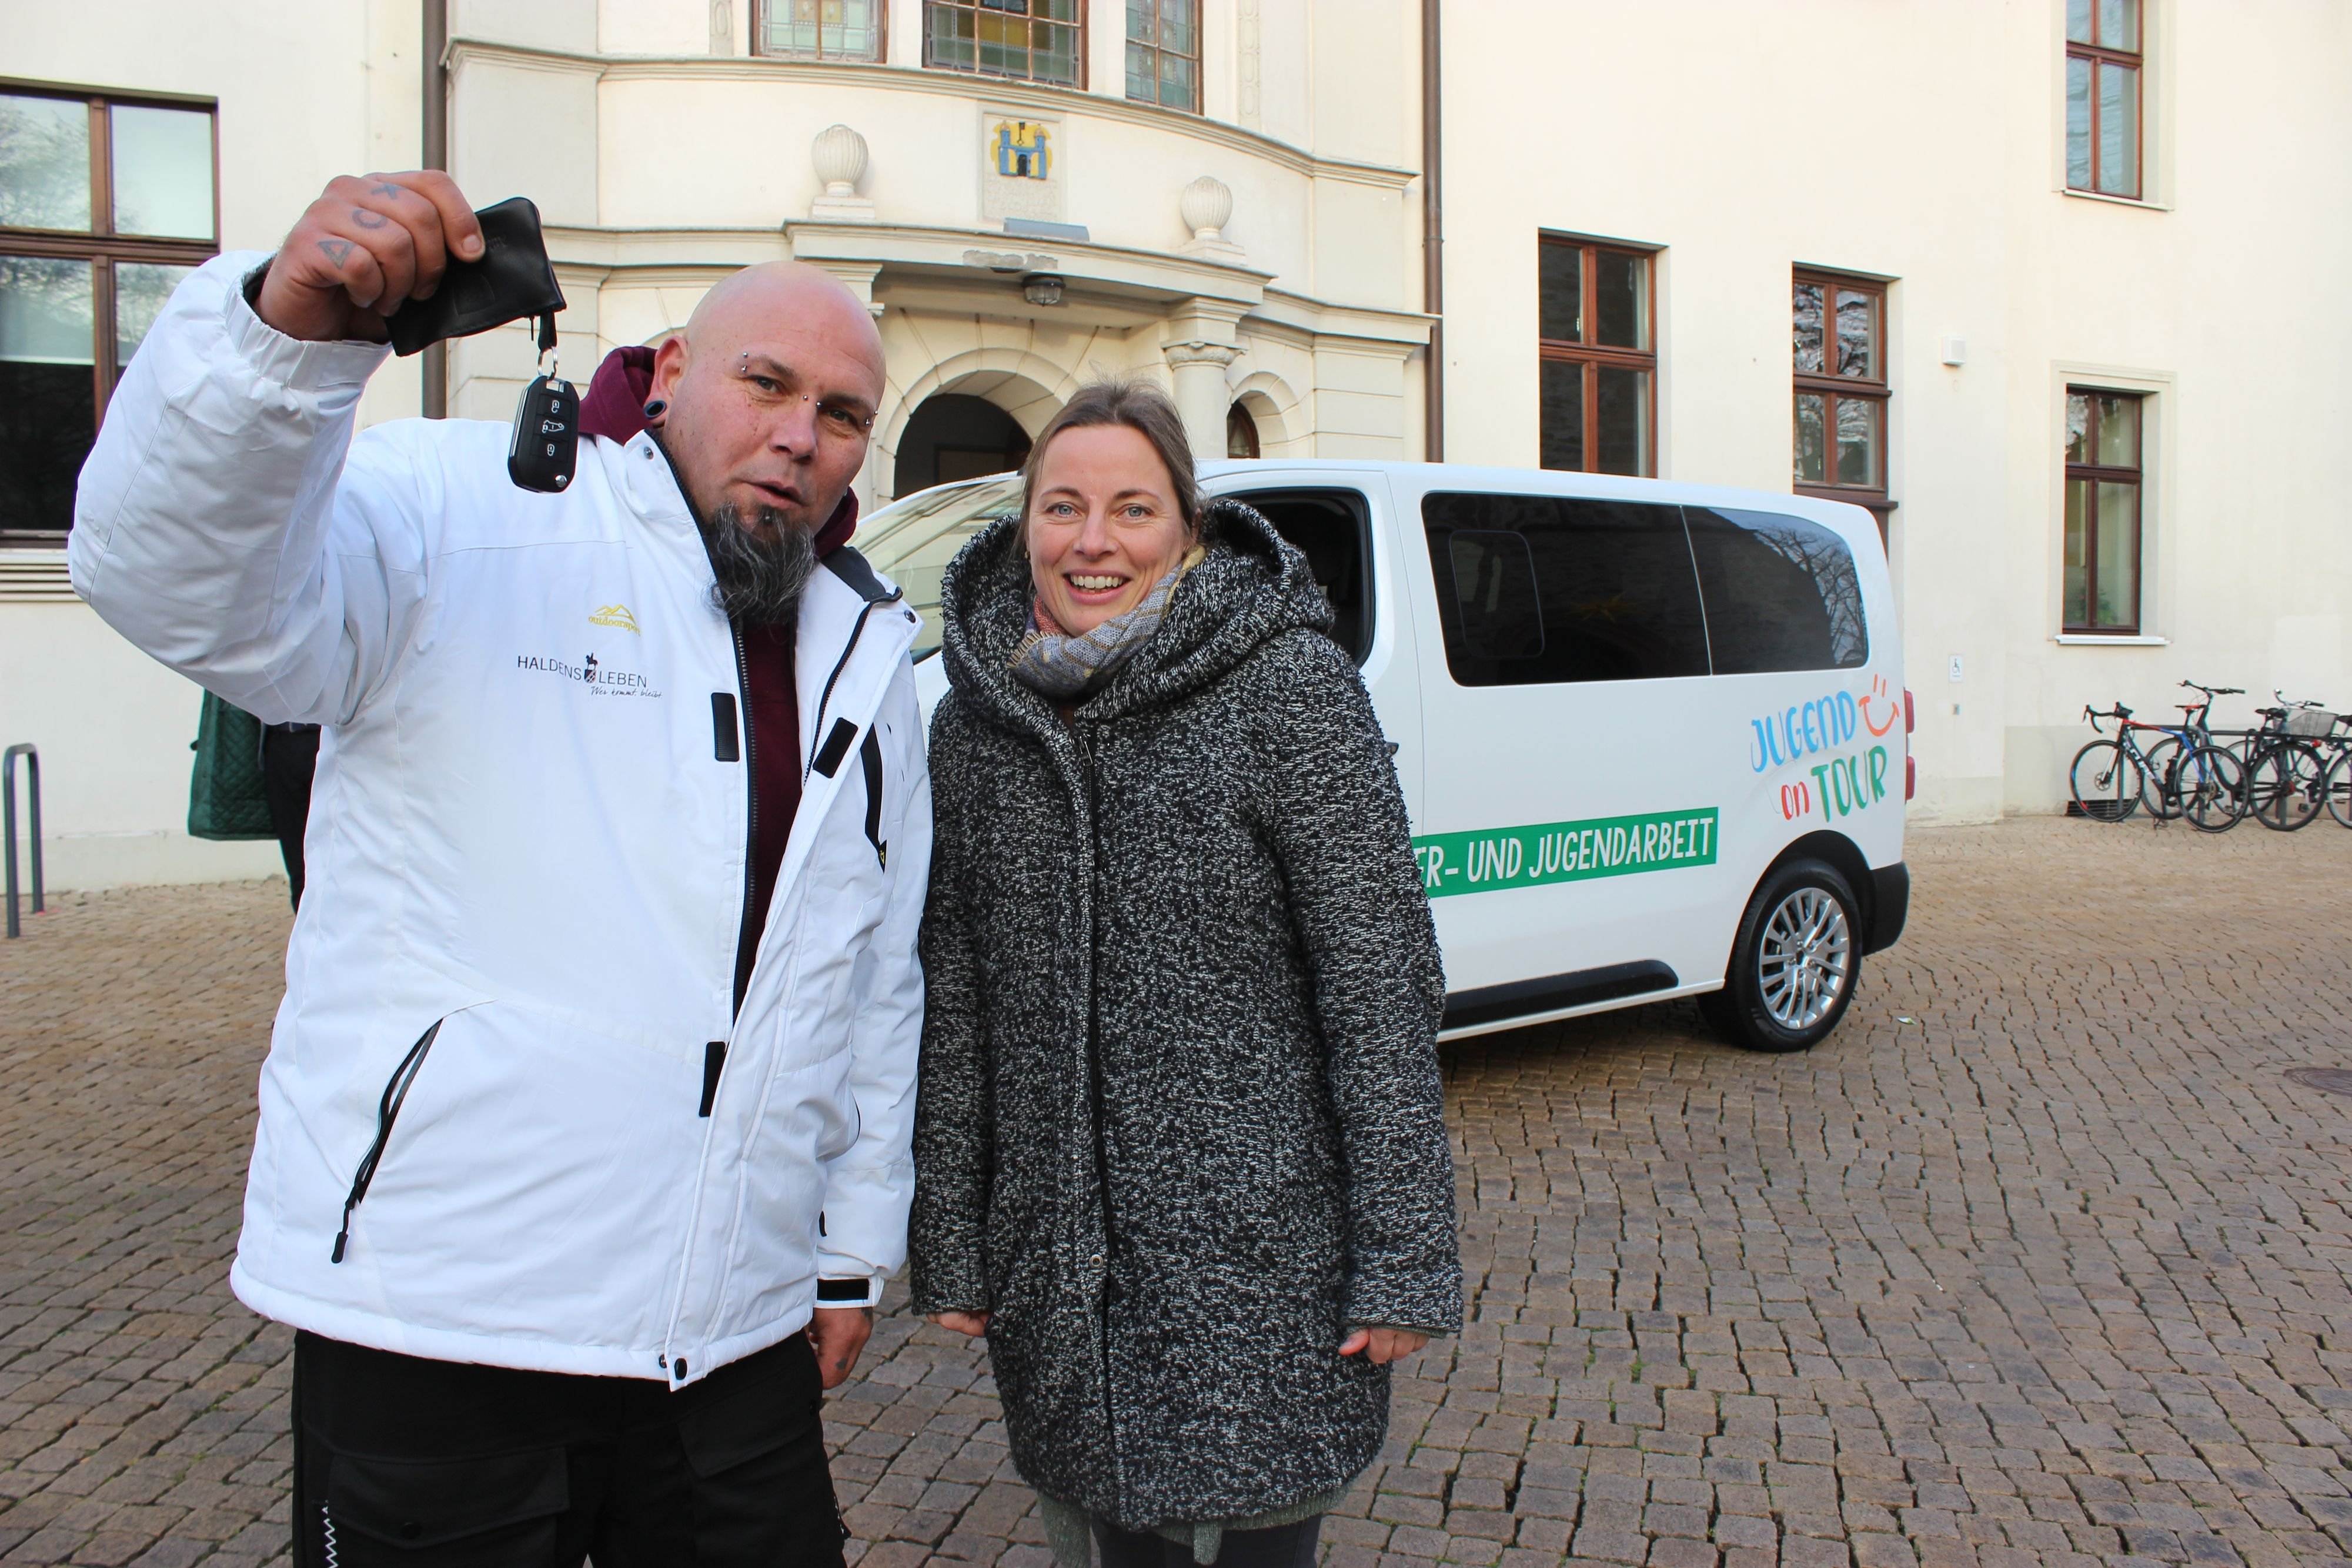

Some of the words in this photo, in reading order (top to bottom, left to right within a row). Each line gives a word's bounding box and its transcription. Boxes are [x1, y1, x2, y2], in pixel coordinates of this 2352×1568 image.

[590, 686, 608, 696] Wer
[1811, 745, 1887, 823] TOUR
[1467, 837, 1522, 882] UND
[1529, 817, 1713, 878] JUGENDARBEIT
